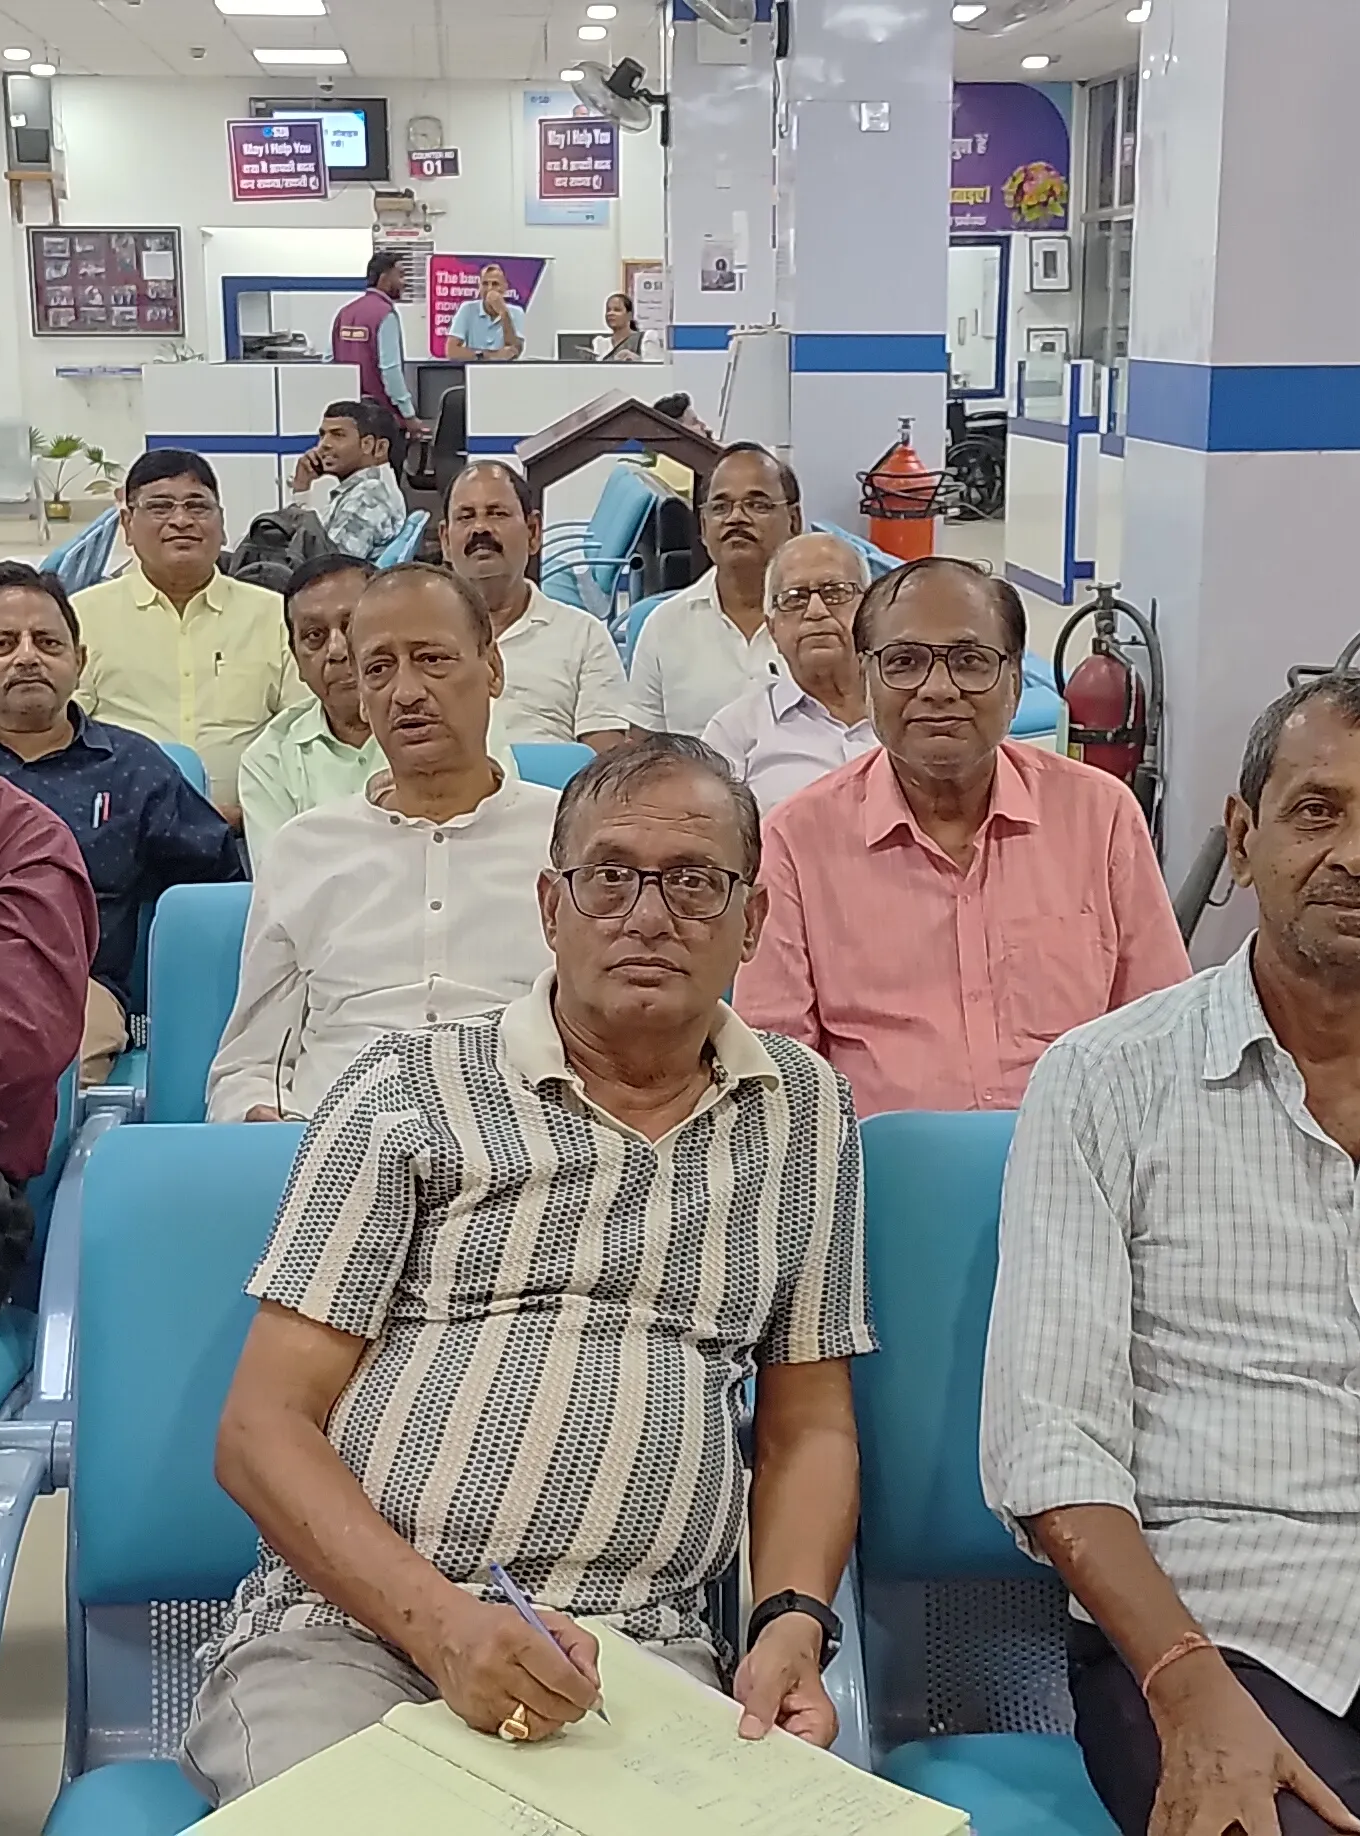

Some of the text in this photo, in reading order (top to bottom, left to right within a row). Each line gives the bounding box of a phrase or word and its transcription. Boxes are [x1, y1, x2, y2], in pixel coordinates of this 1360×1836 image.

[547, 128, 611, 149] May I Help You
[242, 141, 312, 157] May I Help You
[411, 151, 455, 160] COUNTER NO
[422, 159, 442, 175] 01
[435, 270, 480, 284] The ban
[436, 285, 480, 299] to every
